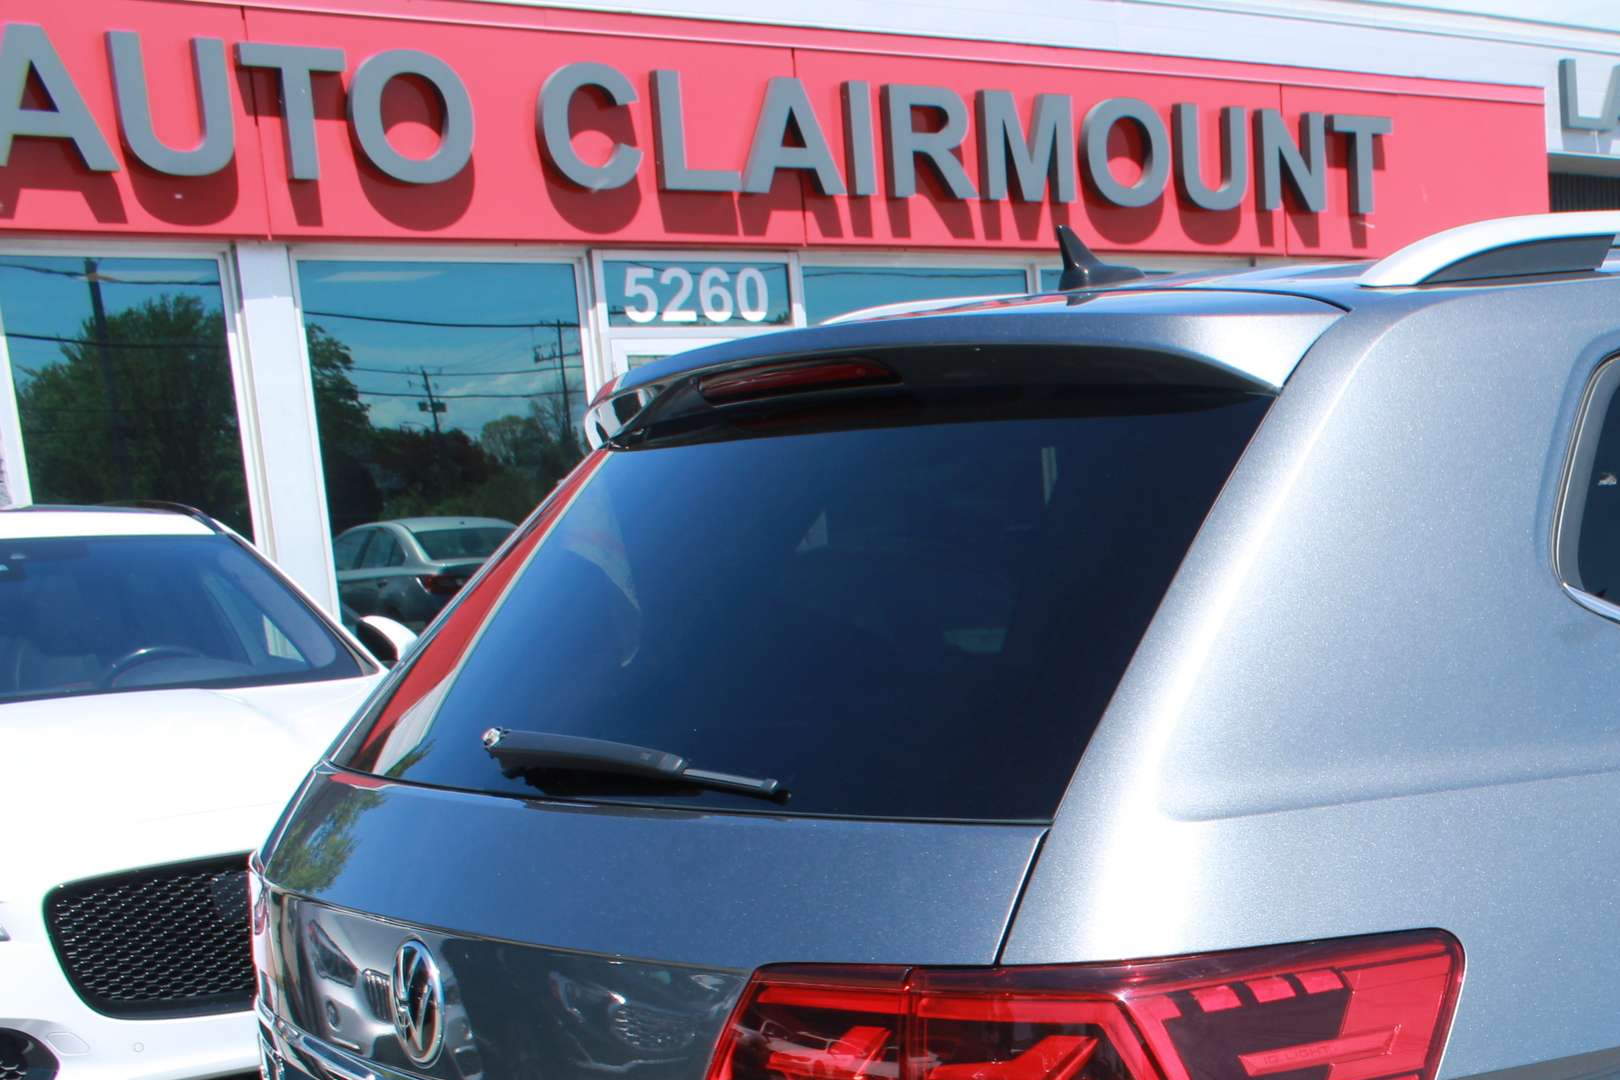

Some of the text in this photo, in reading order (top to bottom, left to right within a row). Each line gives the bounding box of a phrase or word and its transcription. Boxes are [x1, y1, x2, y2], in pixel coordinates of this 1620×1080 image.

[0, 23, 1393, 214] AUTO CLAIRMOUNT
[623, 266, 769, 323] 5260
